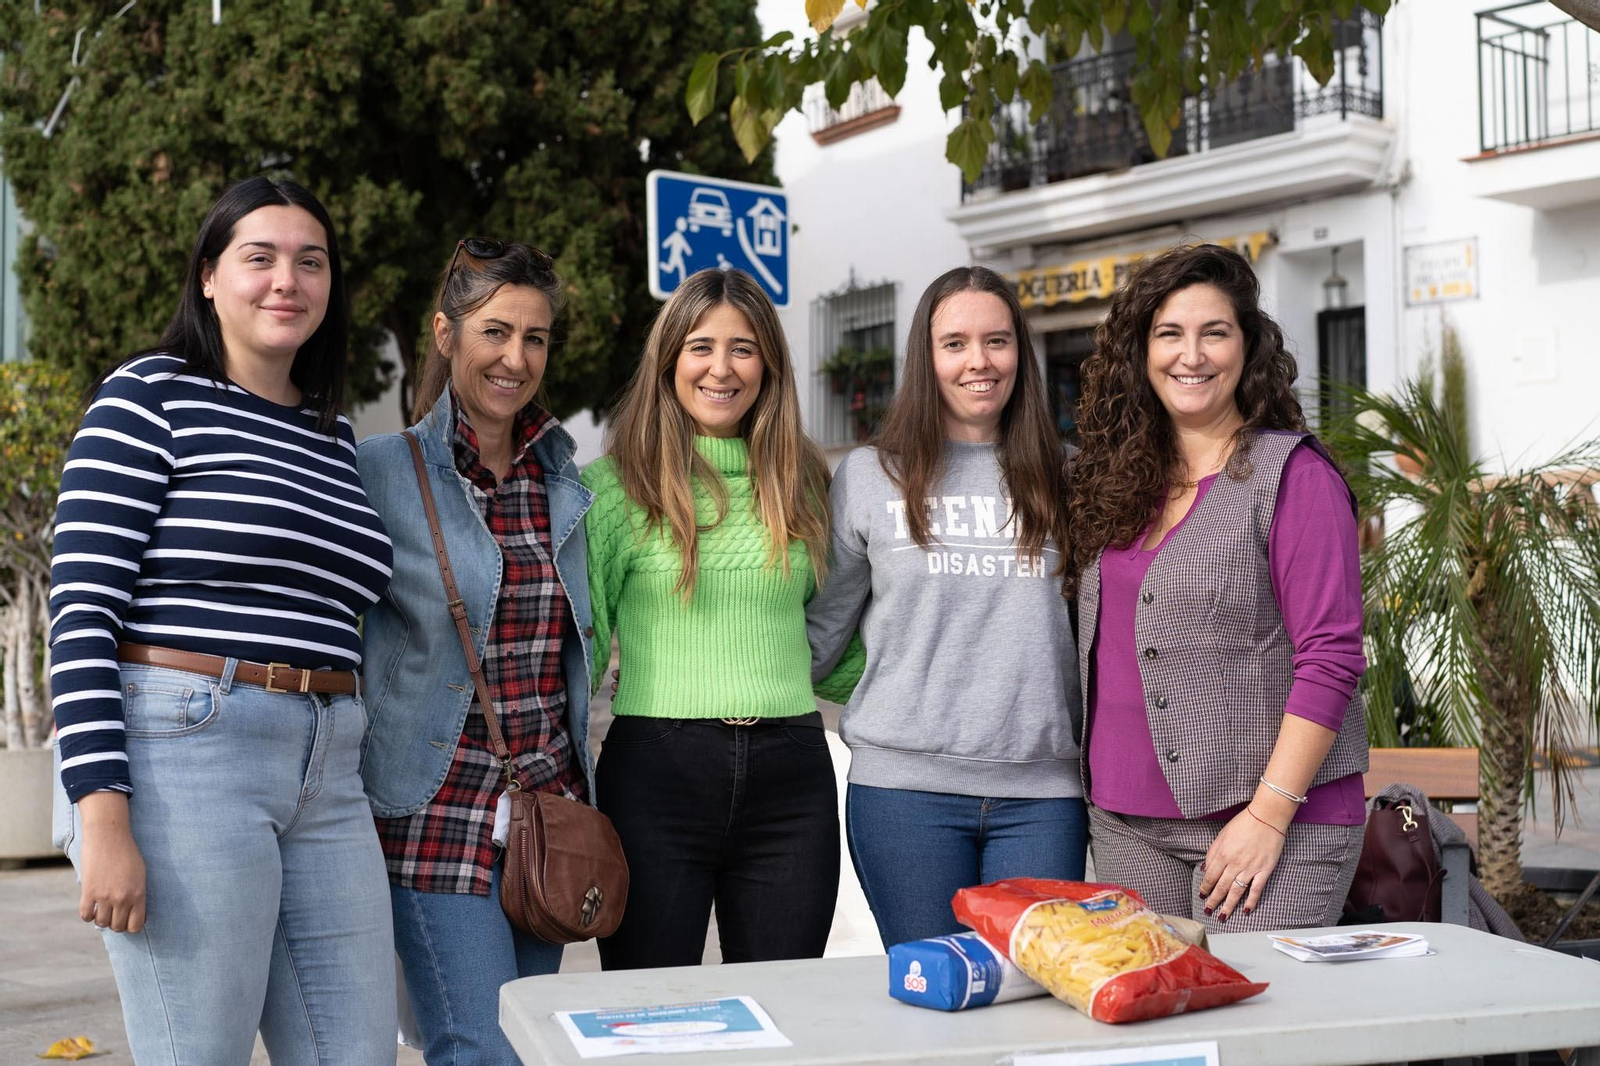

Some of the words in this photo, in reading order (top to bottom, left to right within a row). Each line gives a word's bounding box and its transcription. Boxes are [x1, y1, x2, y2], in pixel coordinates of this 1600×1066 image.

[1013, 266, 1102, 298] OGUERIA
[927, 552, 1046, 578] DISASTER
[905, 976, 926, 991] SOS
